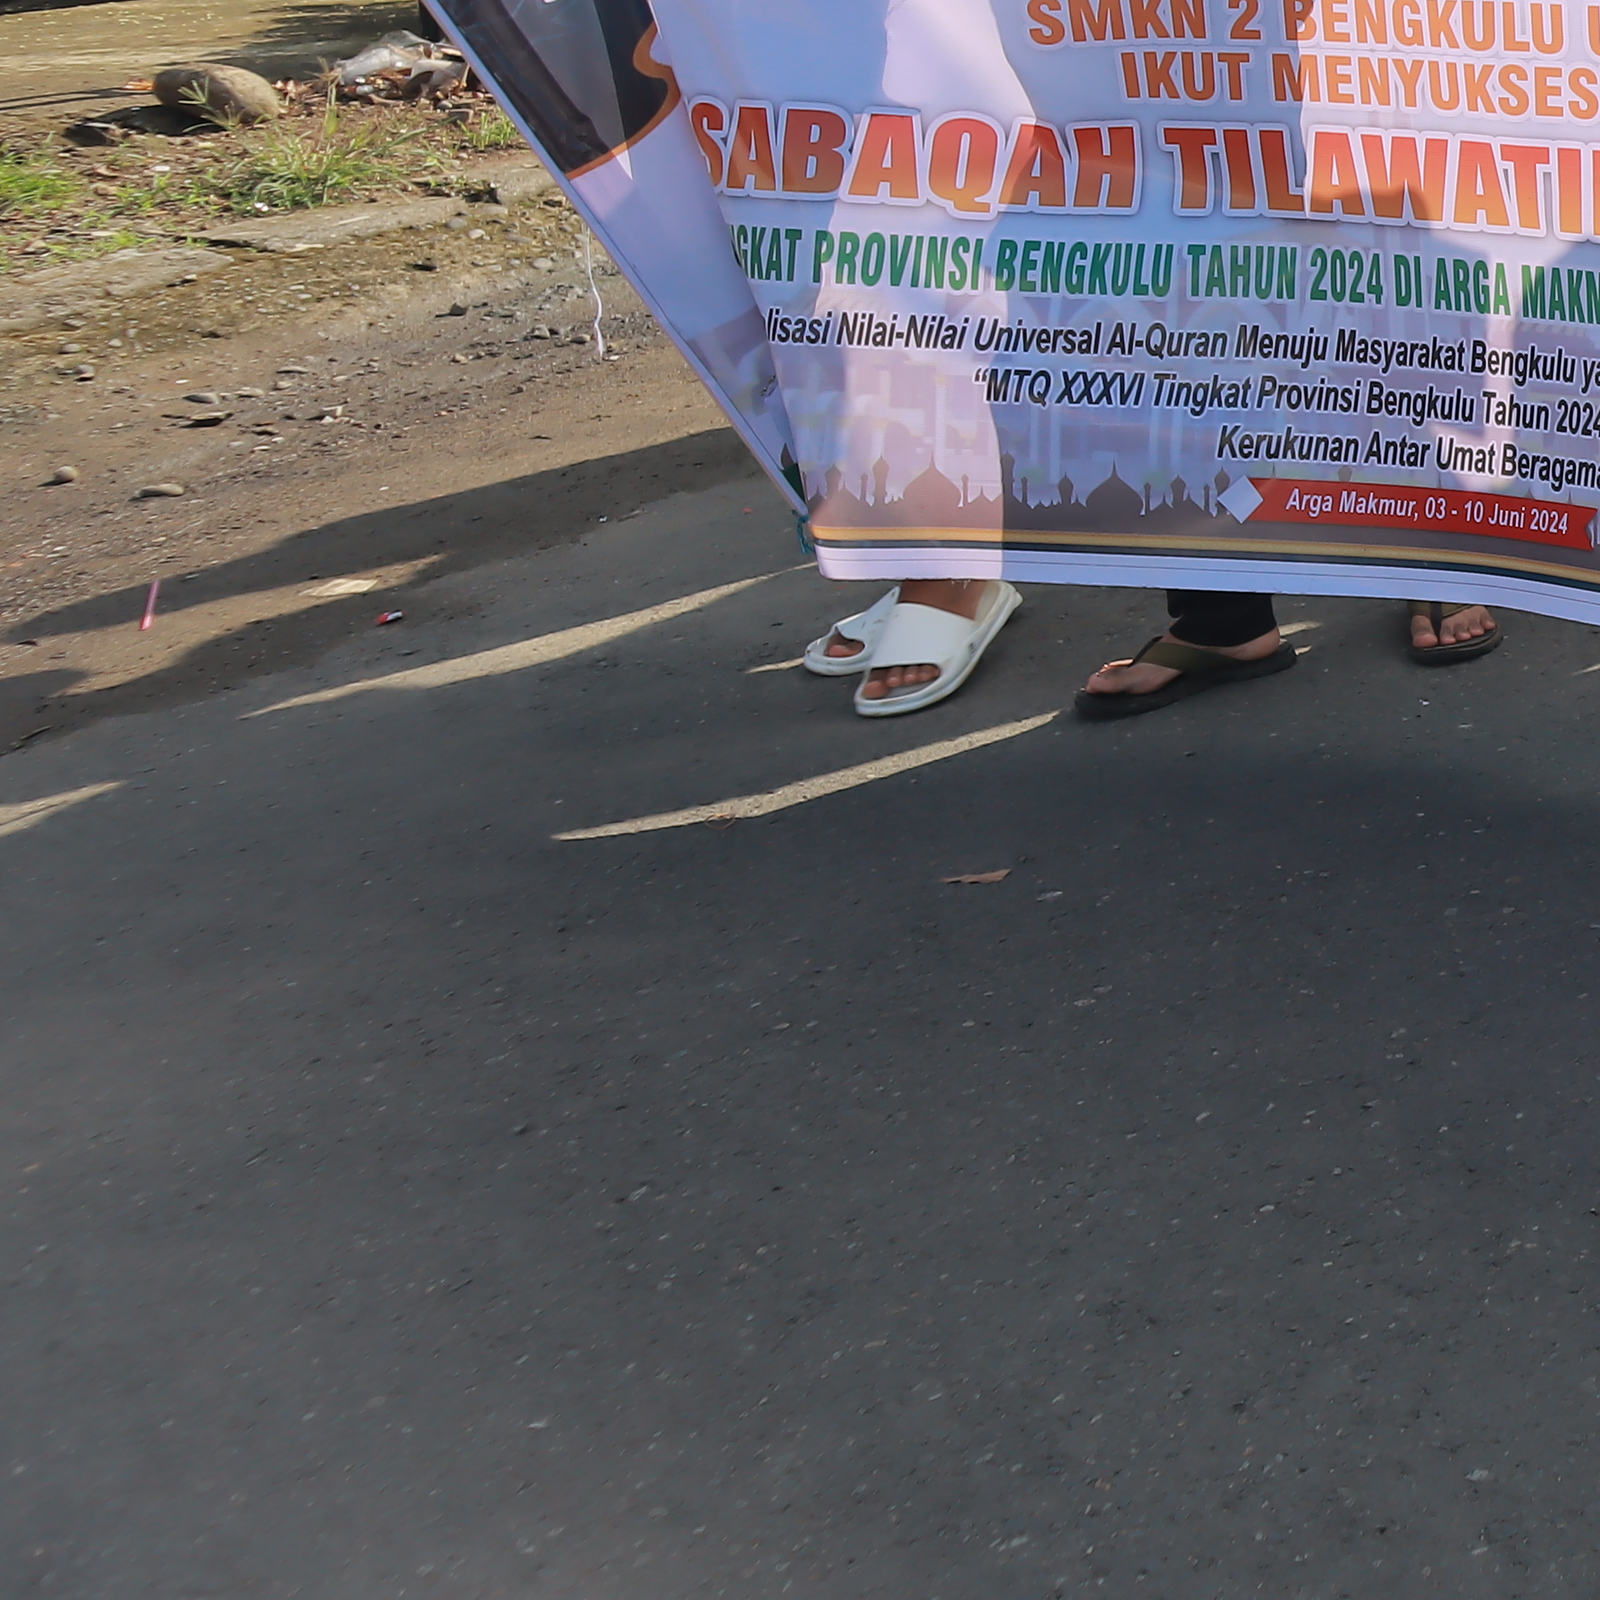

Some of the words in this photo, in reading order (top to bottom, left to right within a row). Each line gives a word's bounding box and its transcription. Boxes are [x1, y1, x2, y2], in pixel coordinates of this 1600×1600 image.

[1119, 52, 1252, 101] IKUT
[813, 229, 982, 290] PROVINSI
[995, 238, 1173, 298] BENGKULU
[1187, 242, 1297, 300] TAHUN
[1310, 247, 1383, 305] 2024
[1394, 255, 1423, 308] DI
[1434, 257, 1510, 315] ARGA
[836, 312, 970, 350] Nilai-Nilai
[974, 316, 1102, 355] Universal
[1105, 320, 1228, 360] Al-Quran
[1235, 325, 1328, 362] Menuju
[1335, 329, 1466, 374] Masyarakat
[1471, 340, 1576, 387] Bengkulu
[1059, 370, 1144, 406] XXXVI
[1152, 373, 1251, 416] Tingkat
[1256, 375, 1361, 414] Provinsi
[1366, 381, 1476, 427] Bengkulu
[1481, 390, 1550, 431] Tahun
[1216, 425, 1364, 464] Kerukunan
[1363, 430, 1430, 468] Antar
[1436, 438, 1496, 475] Umat
[1285, 488, 1336, 516] Arga
[1340, 490, 1420, 523] Makmur,
[1426, 496, 1448, 521] 03
[1463, 501, 1484, 524] 10
[1488, 503, 1525, 531] Juni
[1530, 507, 1569, 535] 2024
